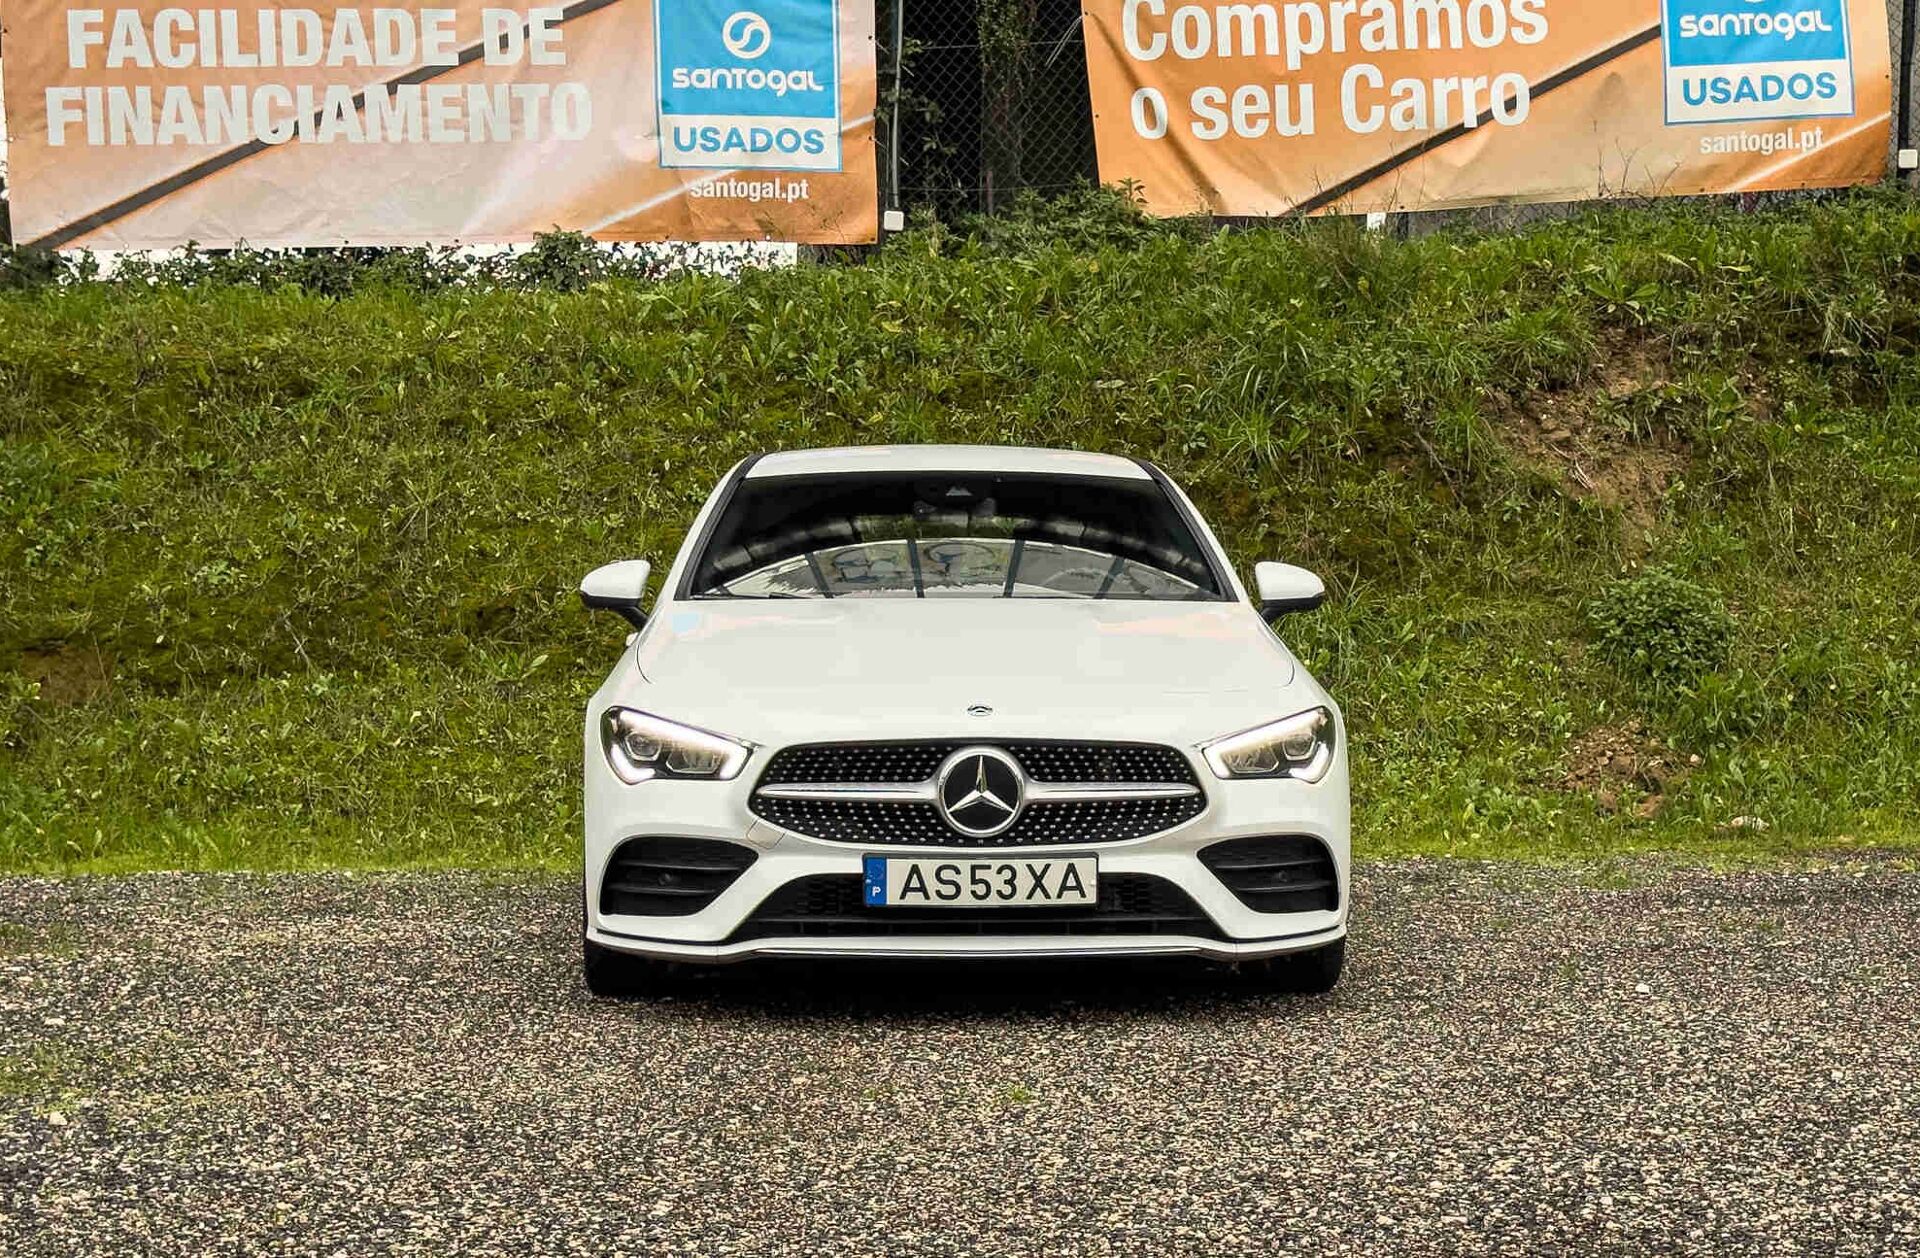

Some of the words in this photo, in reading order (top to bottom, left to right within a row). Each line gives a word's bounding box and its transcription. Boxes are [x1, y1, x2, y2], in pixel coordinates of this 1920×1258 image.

[67, 8, 459, 69] FACILIDADE
[483, 7, 567, 66] DE
[1122, 0, 1549, 71] Compramos
[1680, 9, 1833, 41] santogal
[672, 67, 824, 97] santogal
[1682, 72, 1837, 106] USADOS
[45, 83, 593, 147] FINANCIAMENTO
[1130, 87, 1169, 140] o
[1190, 82, 1316, 141] seu
[1340, 63, 1531, 134] Carro
[673, 126, 825, 155] USADOS
[1700, 126, 1824, 155] santogal.pt
[690, 177, 809, 203] santogal.pt
[872, 886, 881, 897] P
